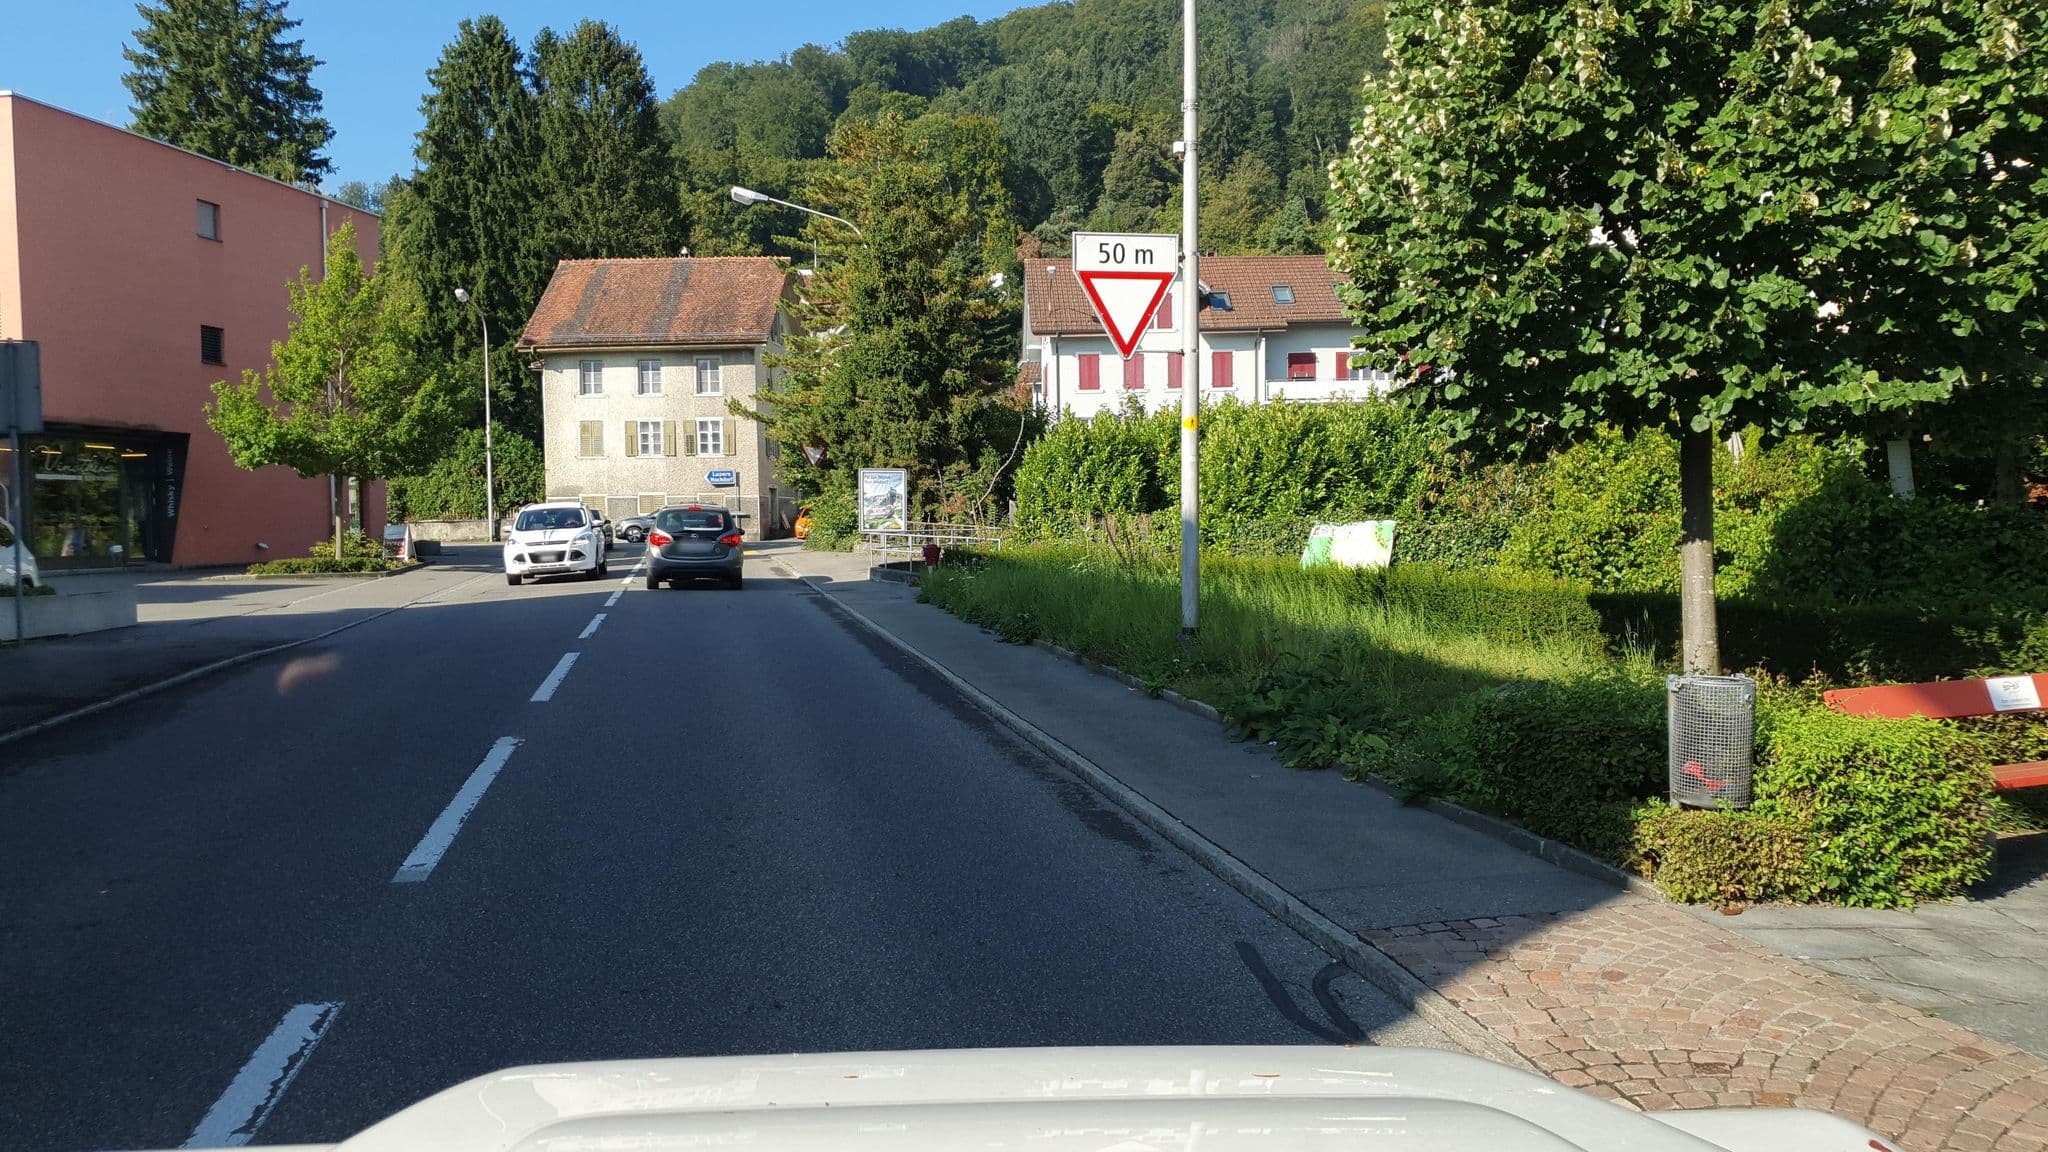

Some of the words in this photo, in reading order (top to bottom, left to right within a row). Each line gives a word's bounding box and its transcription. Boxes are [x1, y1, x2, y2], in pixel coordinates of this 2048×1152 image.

[1098, 242, 1126, 264] 50
[1135, 247, 1154, 265] m
[167, 485, 176, 517] Whisky
